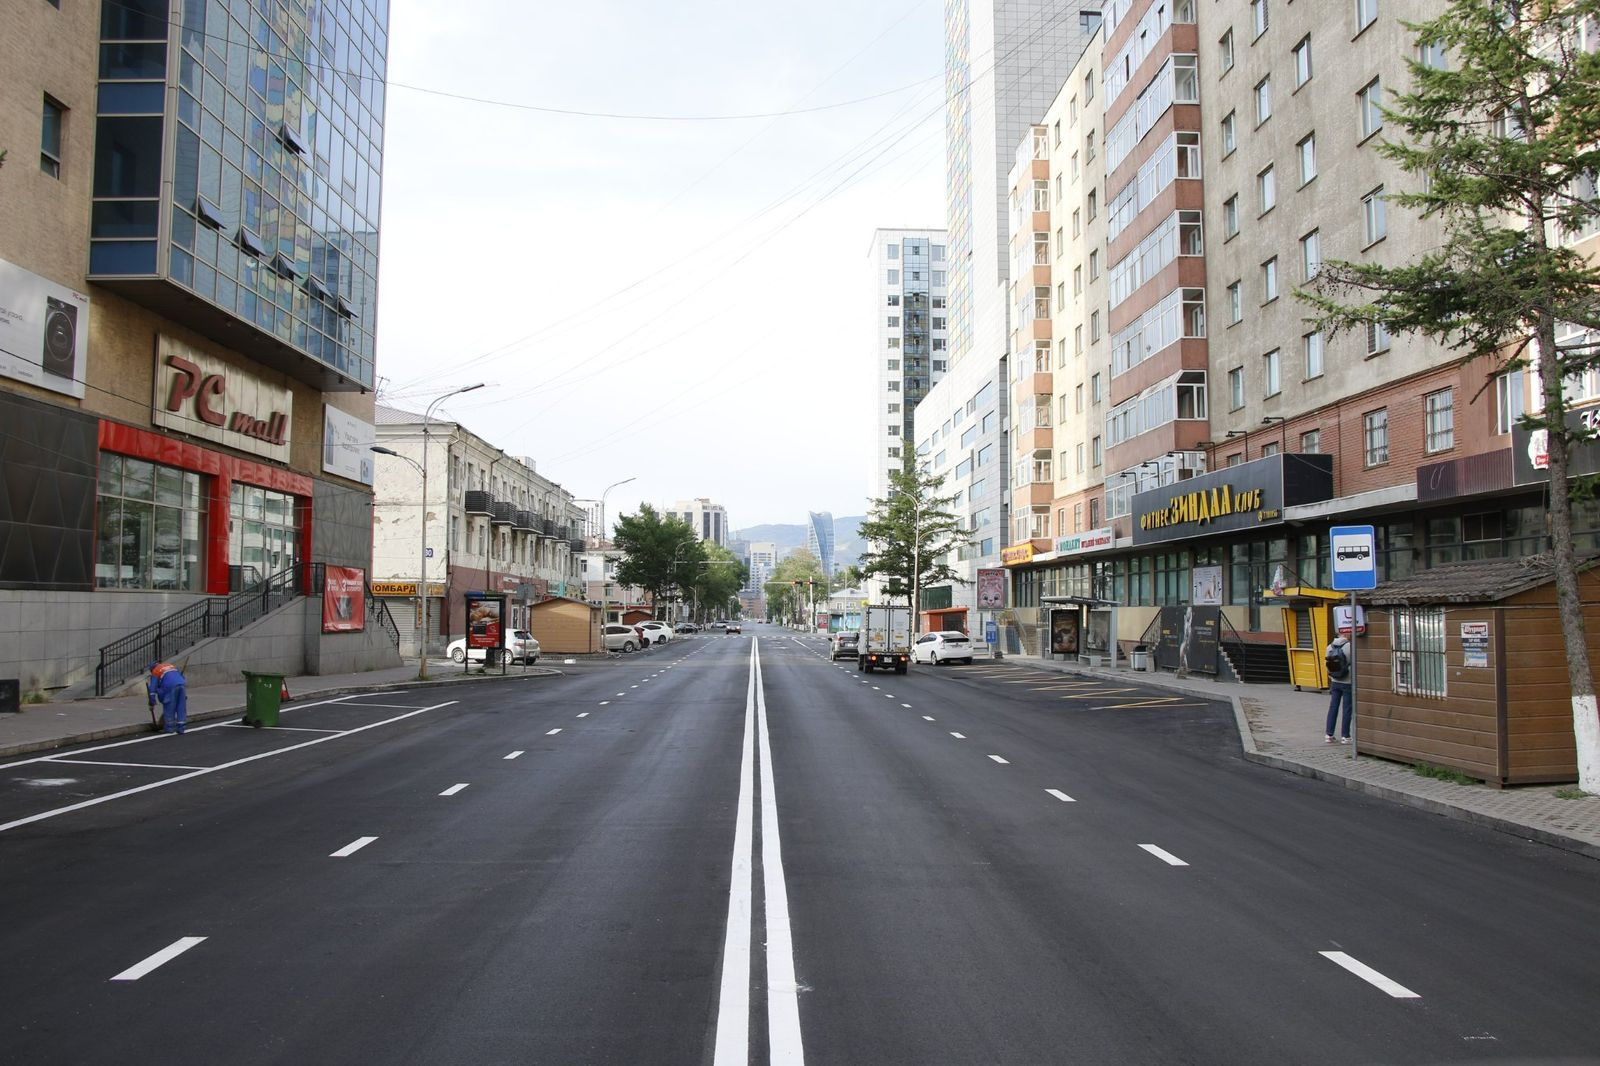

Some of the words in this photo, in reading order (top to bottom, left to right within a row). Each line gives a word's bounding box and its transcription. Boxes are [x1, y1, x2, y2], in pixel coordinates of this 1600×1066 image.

[167, 355, 226, 427] PC
[230, 411, 288, 446] mall
[1140, 507, 1169, 531] ФИТНЕС
[1235, 489, 1262, 514] КЛУБ
